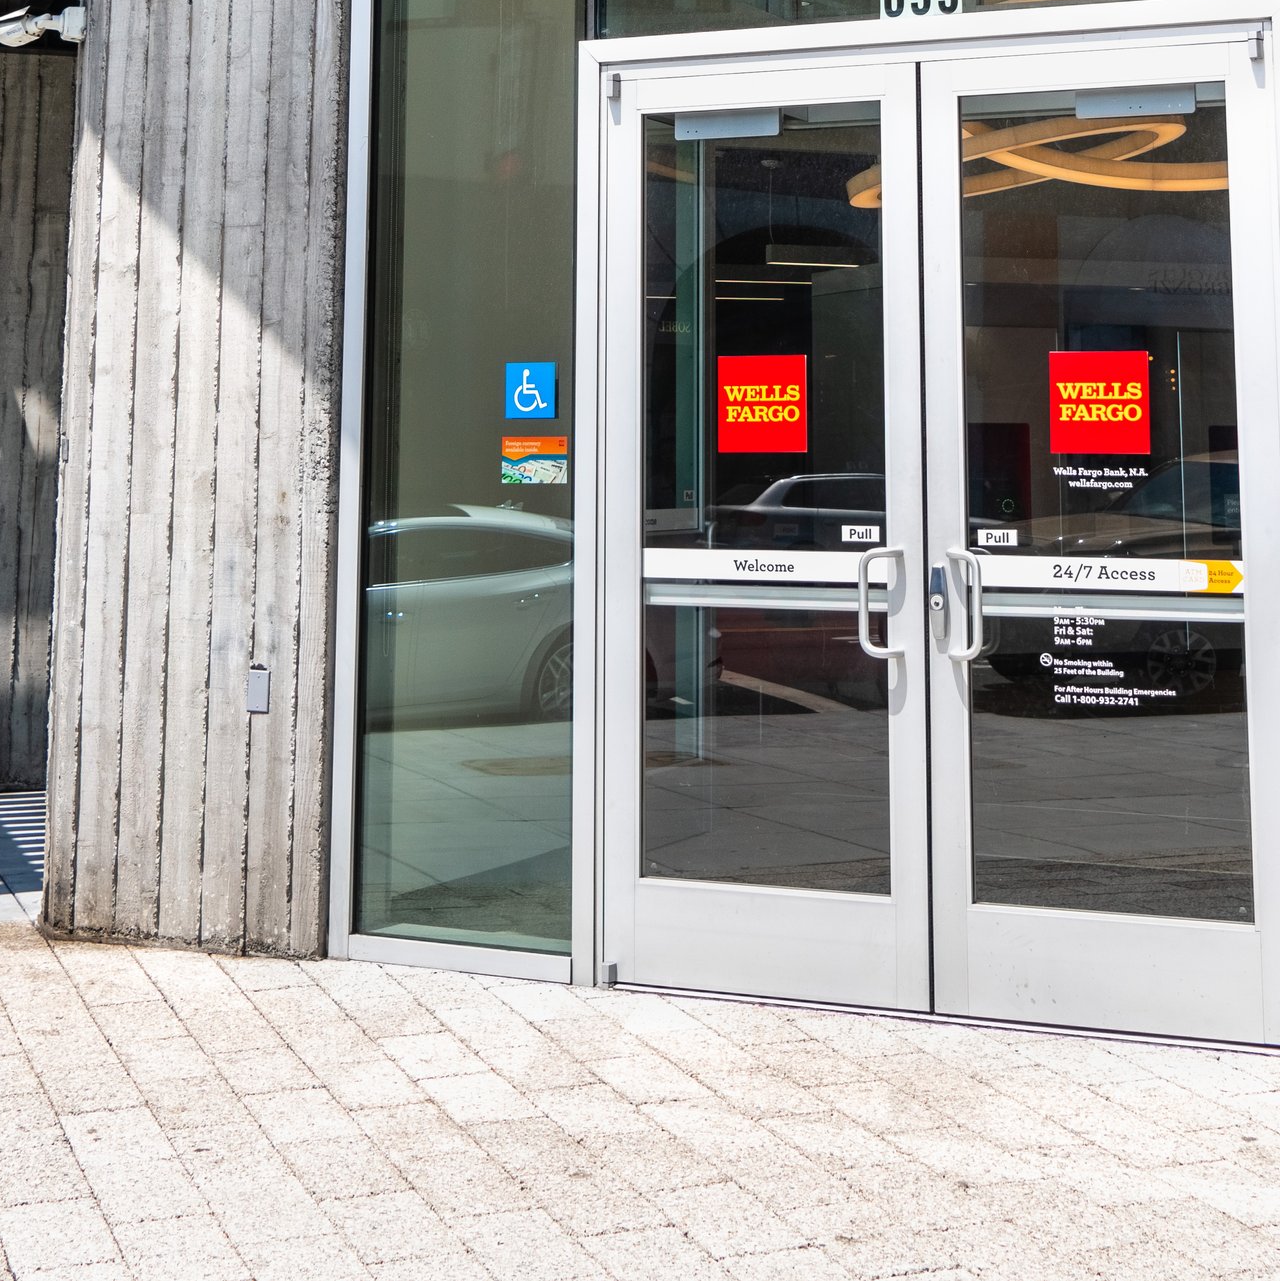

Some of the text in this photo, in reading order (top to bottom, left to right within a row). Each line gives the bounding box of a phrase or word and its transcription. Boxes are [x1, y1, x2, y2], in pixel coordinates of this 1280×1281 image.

[724, 385, 800, 402] WELLS
[1056, 382, 1142, 400] WELLS
[726, 406, 800, 422] FARGO
[1059, 404, 1142, 422] FARGO
[1053, 467, 1148, 477] Wells Fargo Bank, N.A.
[1068, 479, 1133, 489] wellsfargo.com
[849, 529, 872, 539] Pull
[986, 532, 1009, 543] Pull
[734, 559, 795, 572] Welcome
[1053, 564, 1156, 582] 24/7 Access
[1054, 627, 1093, 635] Fri & Sat:
[1064, 659, 1091, 667] Smoking
[1097, 669, 1124, 677] Building
[1105, 687, 1132, 695] Building
[1055, 695, 1139, 705] Call 1-800-932-2741
